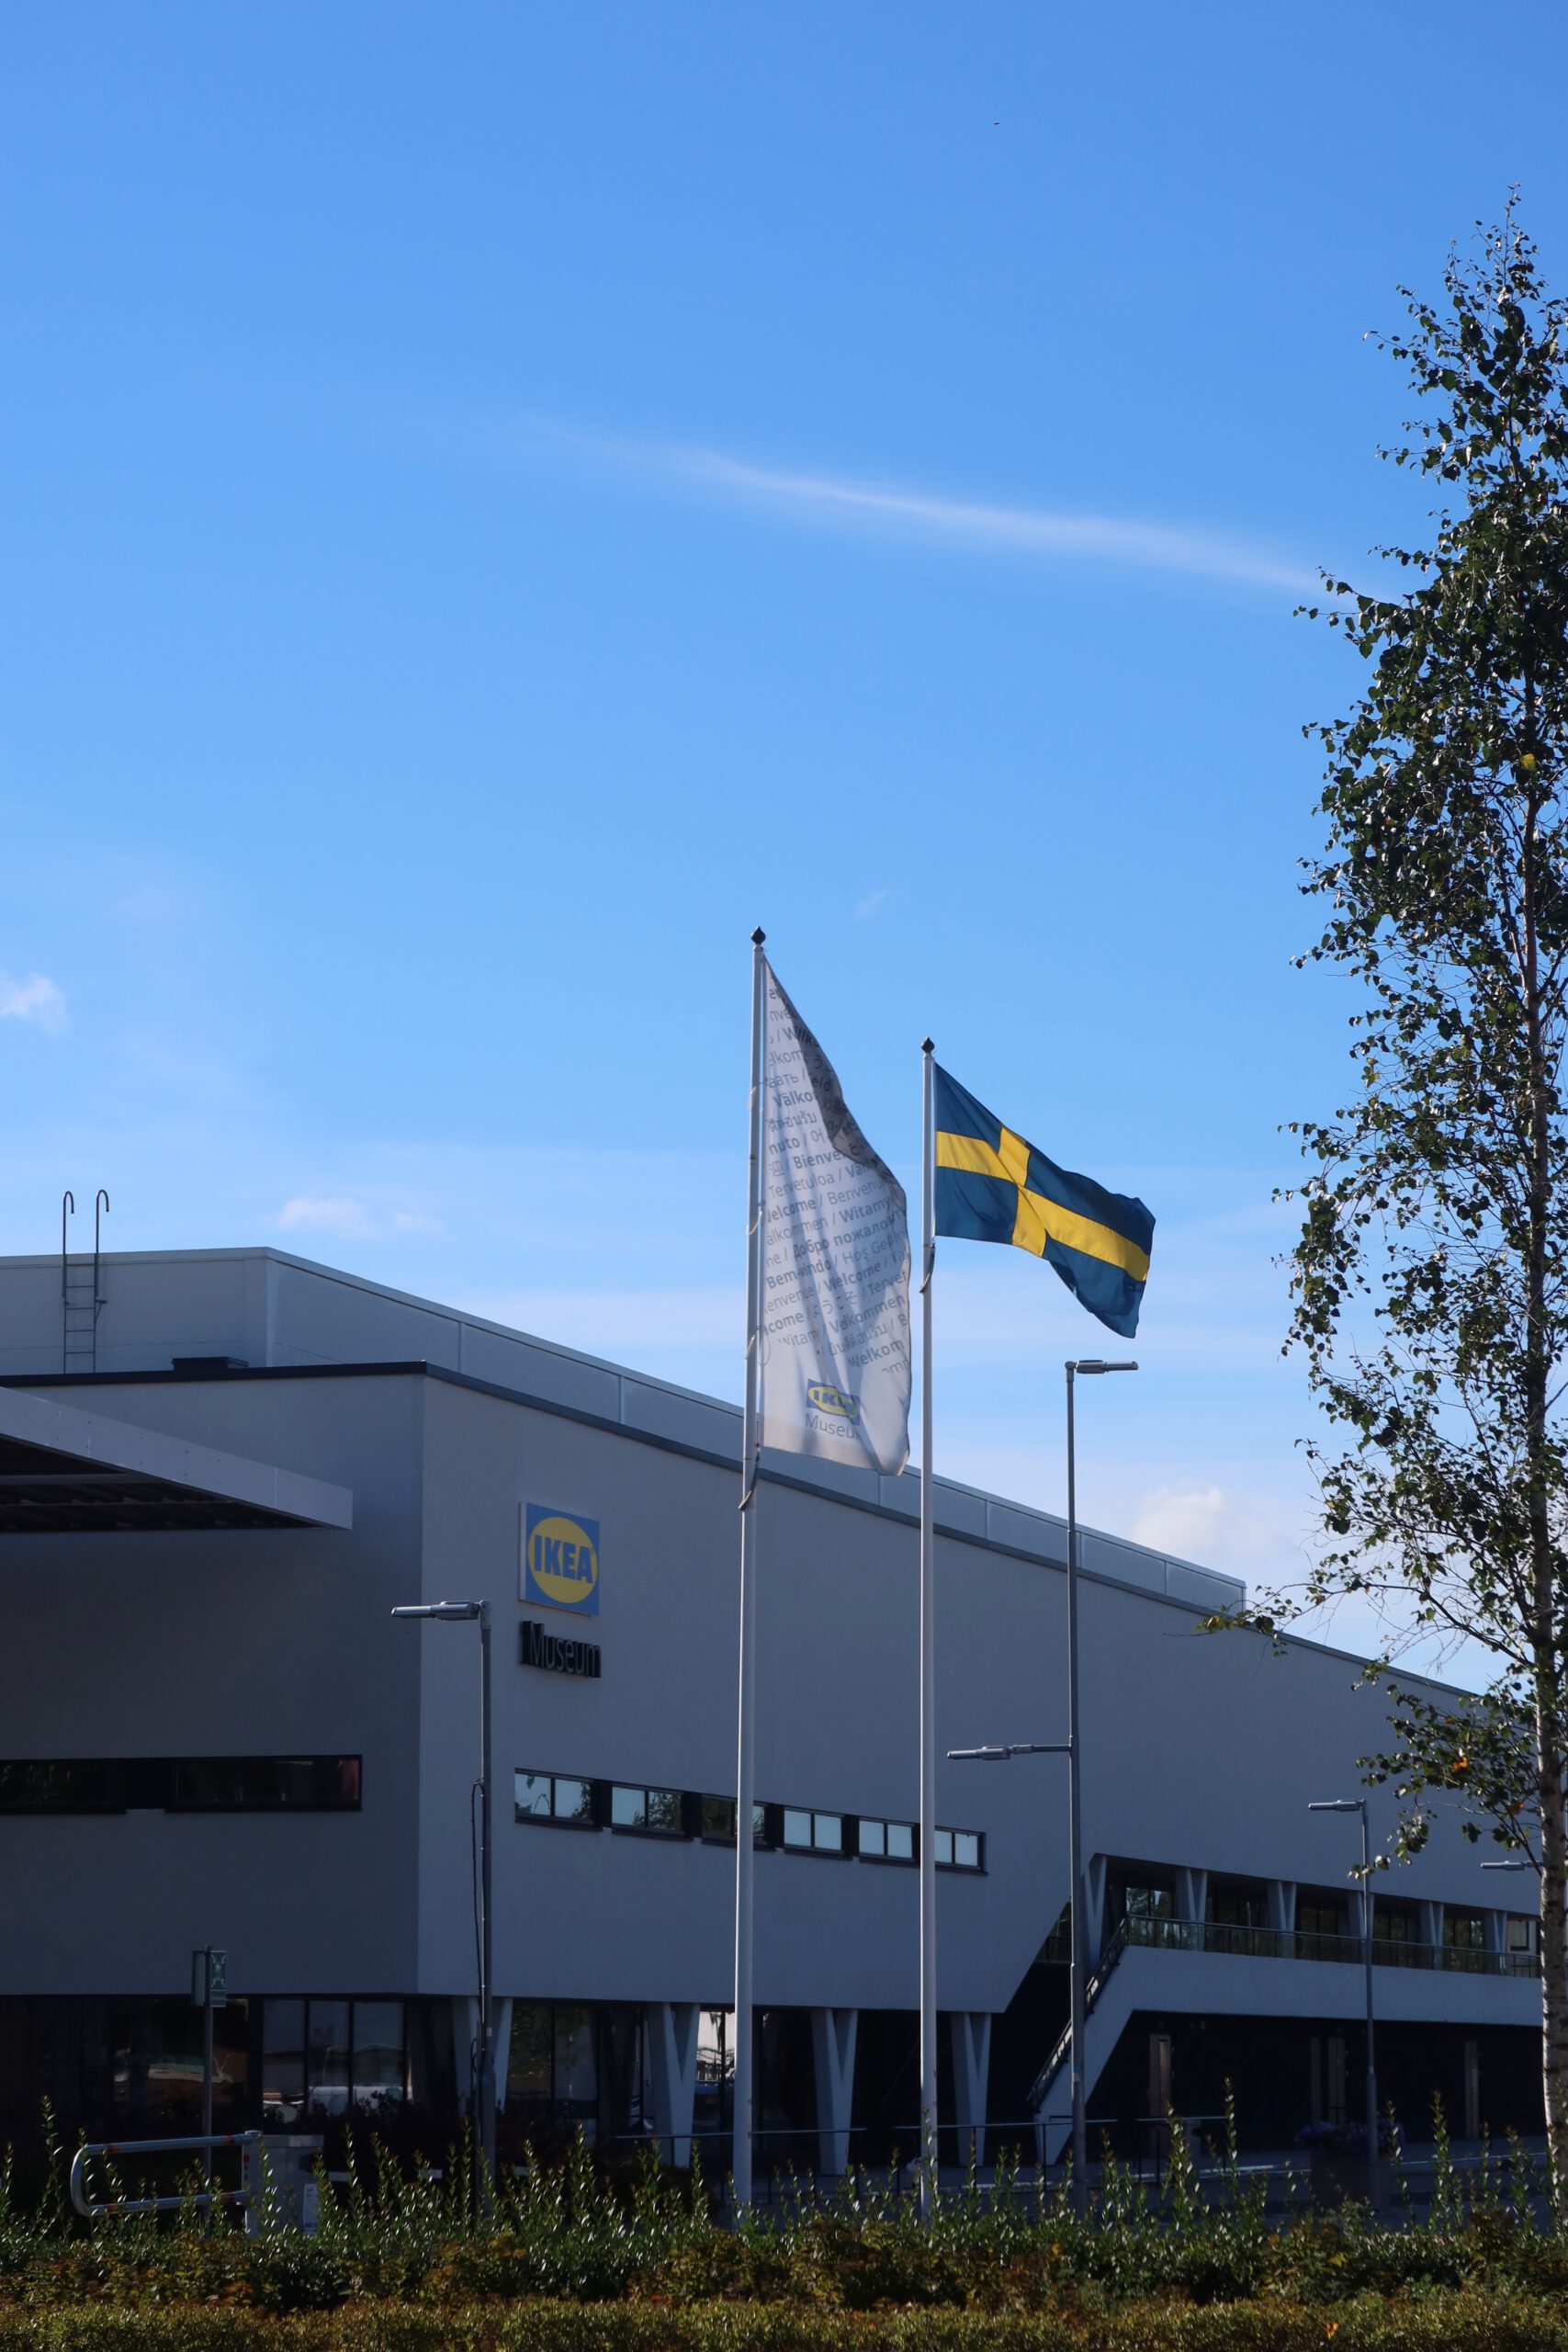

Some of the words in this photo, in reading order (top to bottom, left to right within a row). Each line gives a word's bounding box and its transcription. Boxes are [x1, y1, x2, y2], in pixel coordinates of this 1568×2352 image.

[768, 1173, 835, 1199] Tervetuloa
[840, 1196, 890, 1223] Witamy
[793, 1238, 829, 1261] Добро
[767, 1258, 831, 1289] Bem-vindo
[824, 1262, 881, 1292] Welcome
[829, 1295, 906, 1333] Velkommen
[848, 1339, 906, 1368] Welkom
[534, 1534, 593, 1584] IKEA
[520, 1621, 603, 1679] Museum
